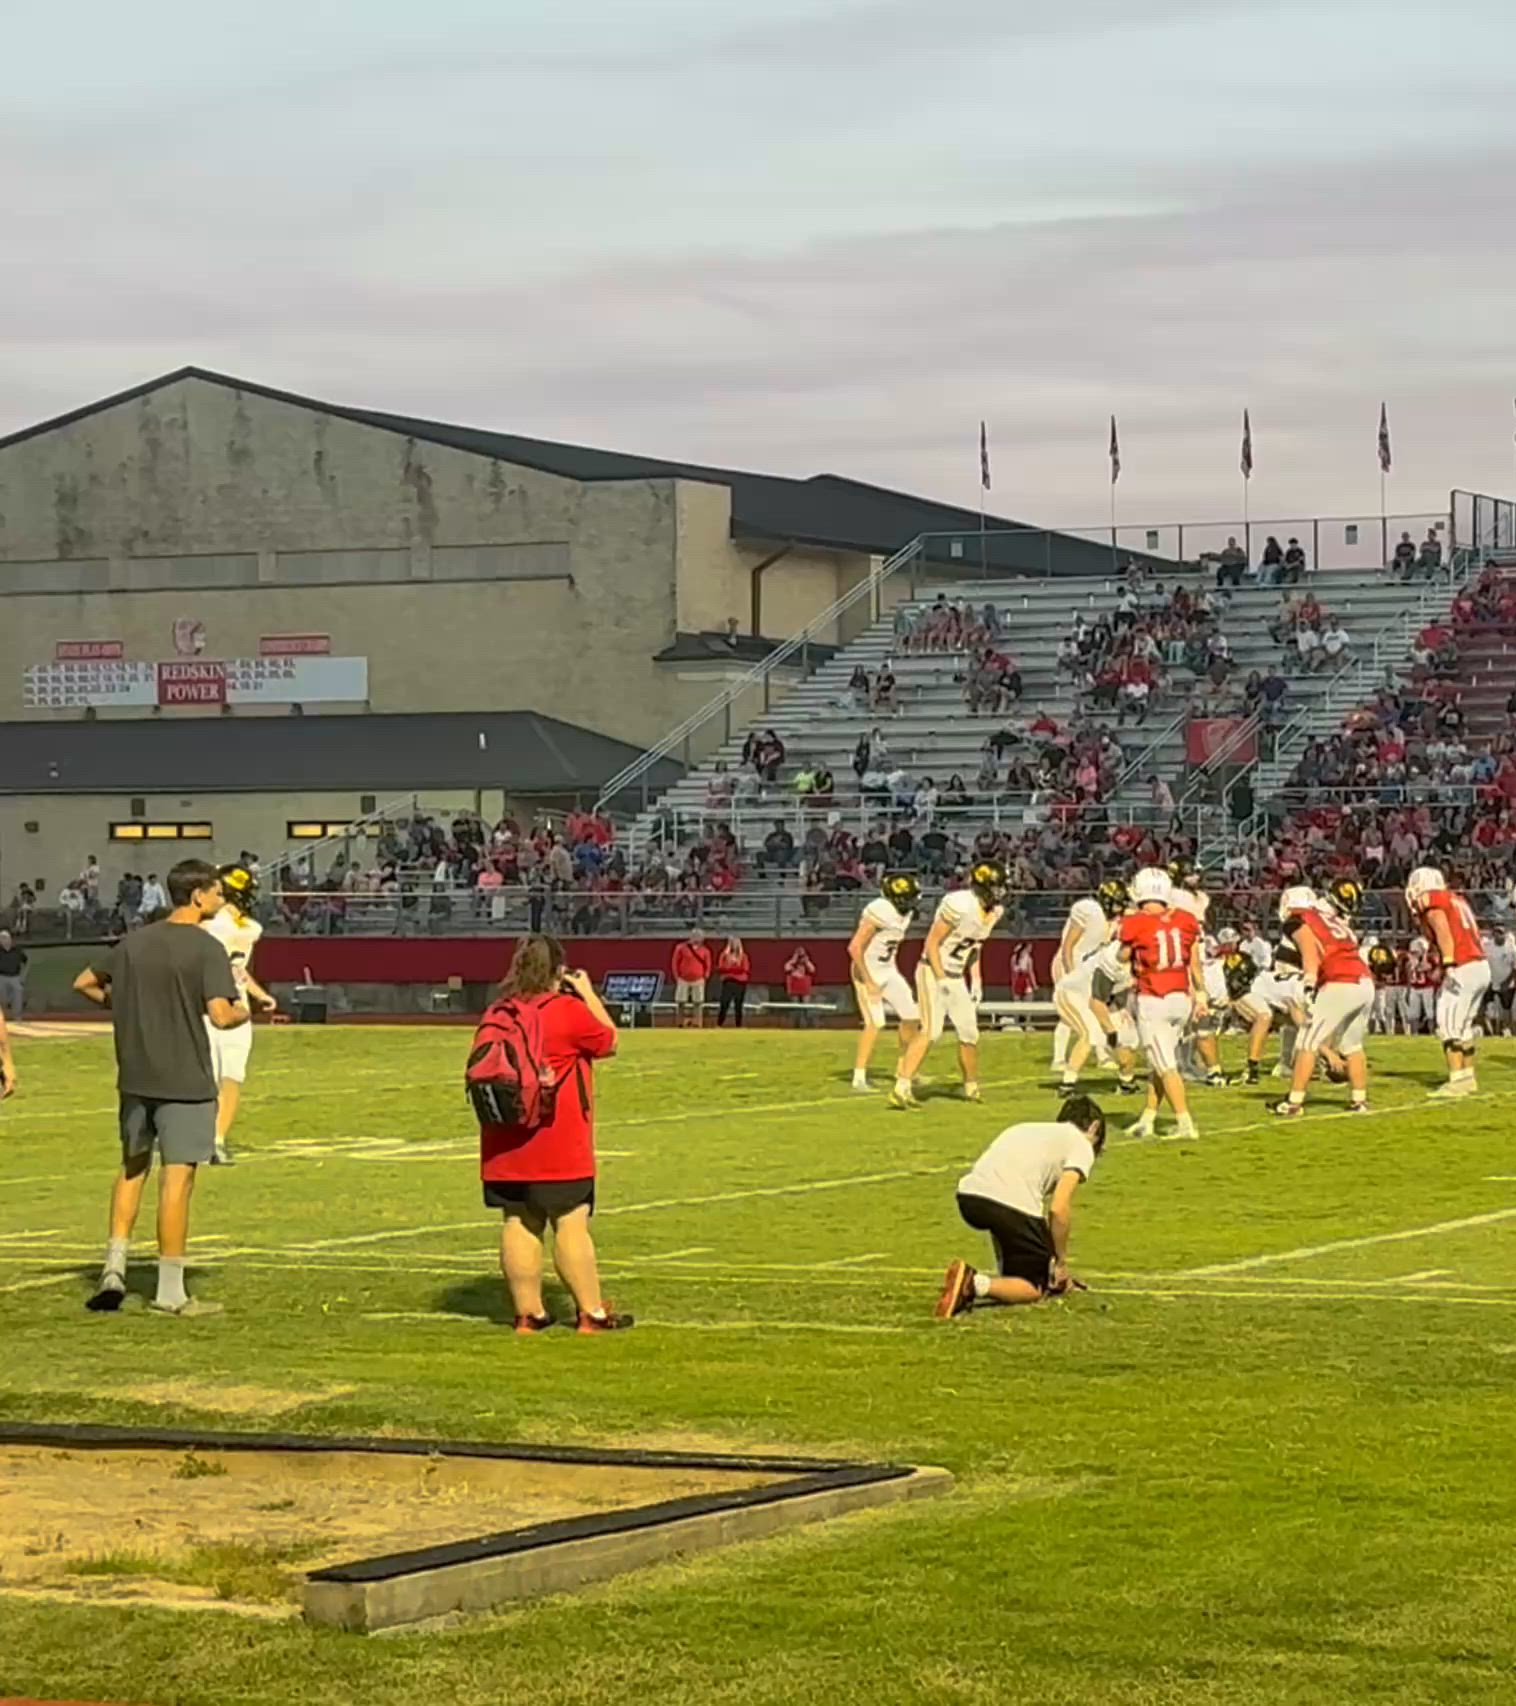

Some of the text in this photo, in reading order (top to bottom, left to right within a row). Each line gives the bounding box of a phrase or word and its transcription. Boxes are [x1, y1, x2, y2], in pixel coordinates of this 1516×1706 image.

[161, 663, 224, 680] REDSKIN
[167, 683, 219, 700] POWER
[1155, 927, 1184, 971] 11
